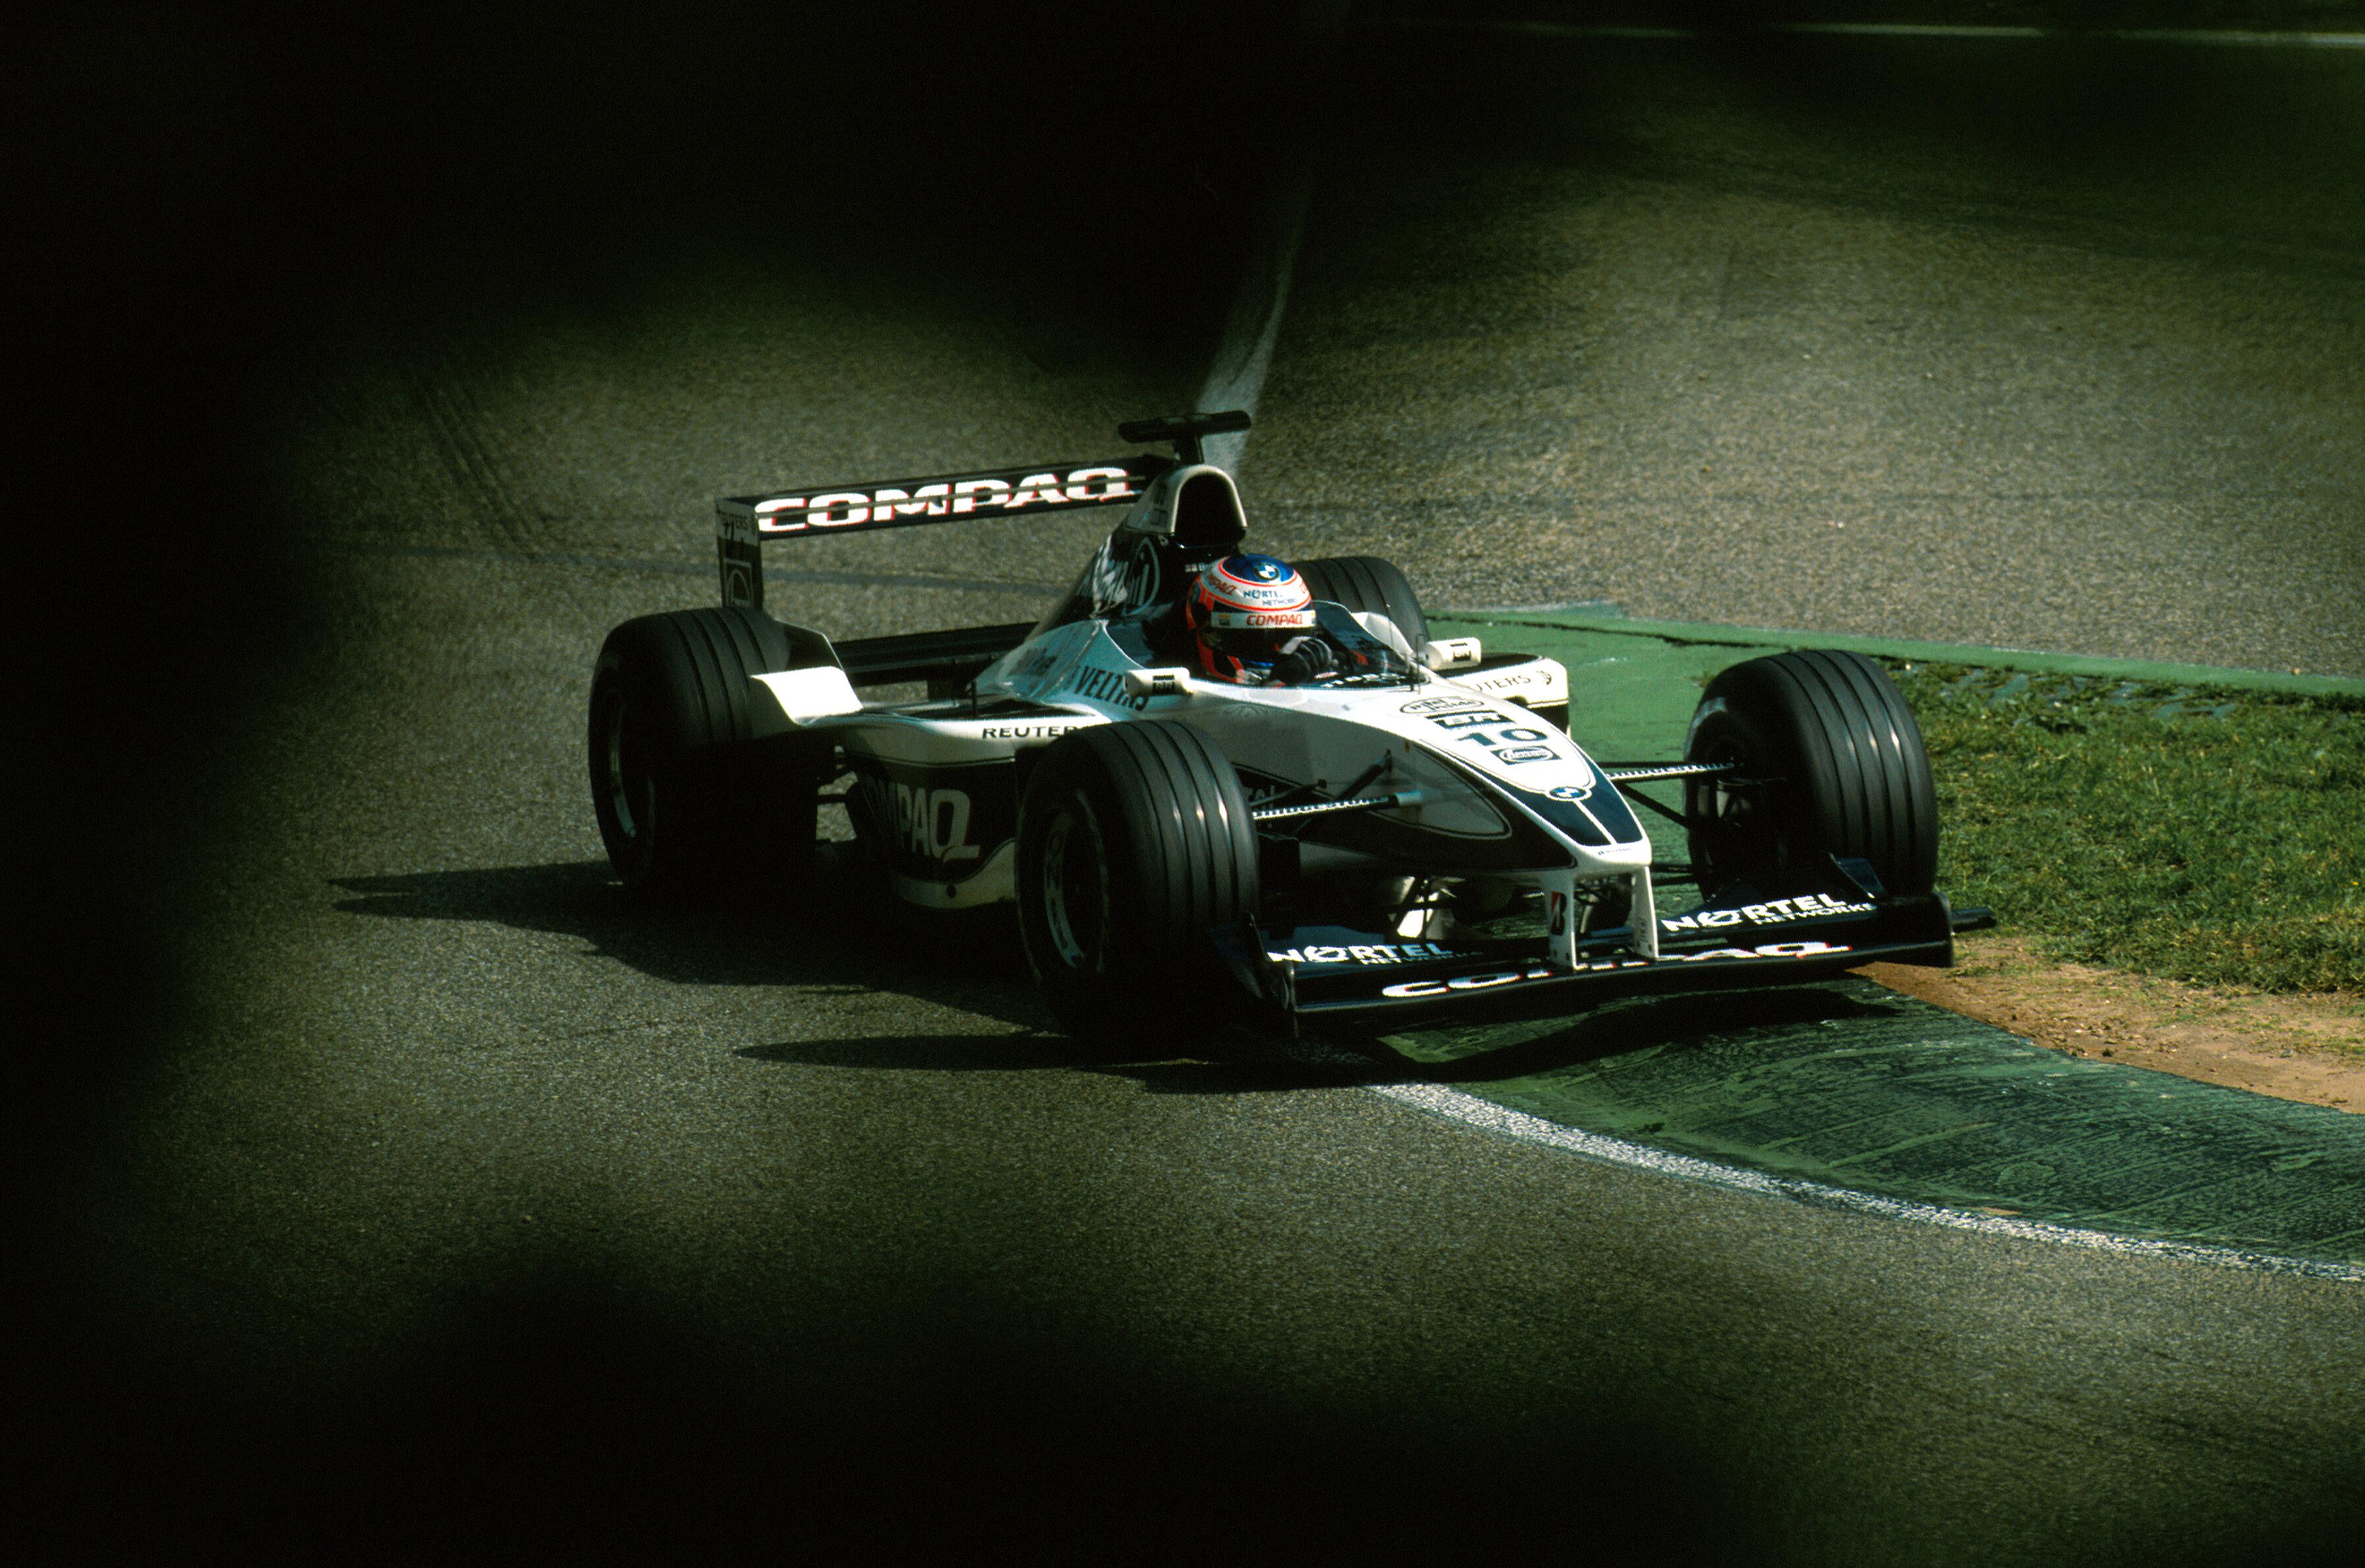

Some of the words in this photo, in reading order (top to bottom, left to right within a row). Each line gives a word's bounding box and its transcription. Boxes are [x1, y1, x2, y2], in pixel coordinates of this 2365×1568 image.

[754, 466, 1143, 533] COMPAQ
[1246, 613, 1302, 625] COMPAQ
[1475, 675, 1531, 692] UTERS
[981, 726, 1079, 739] REUTER
[1455, 728, 1548, 747] 10
[1660, 893, 1846, 931] NORTEL
[1267, 943, 1453, 963] NORTEL
